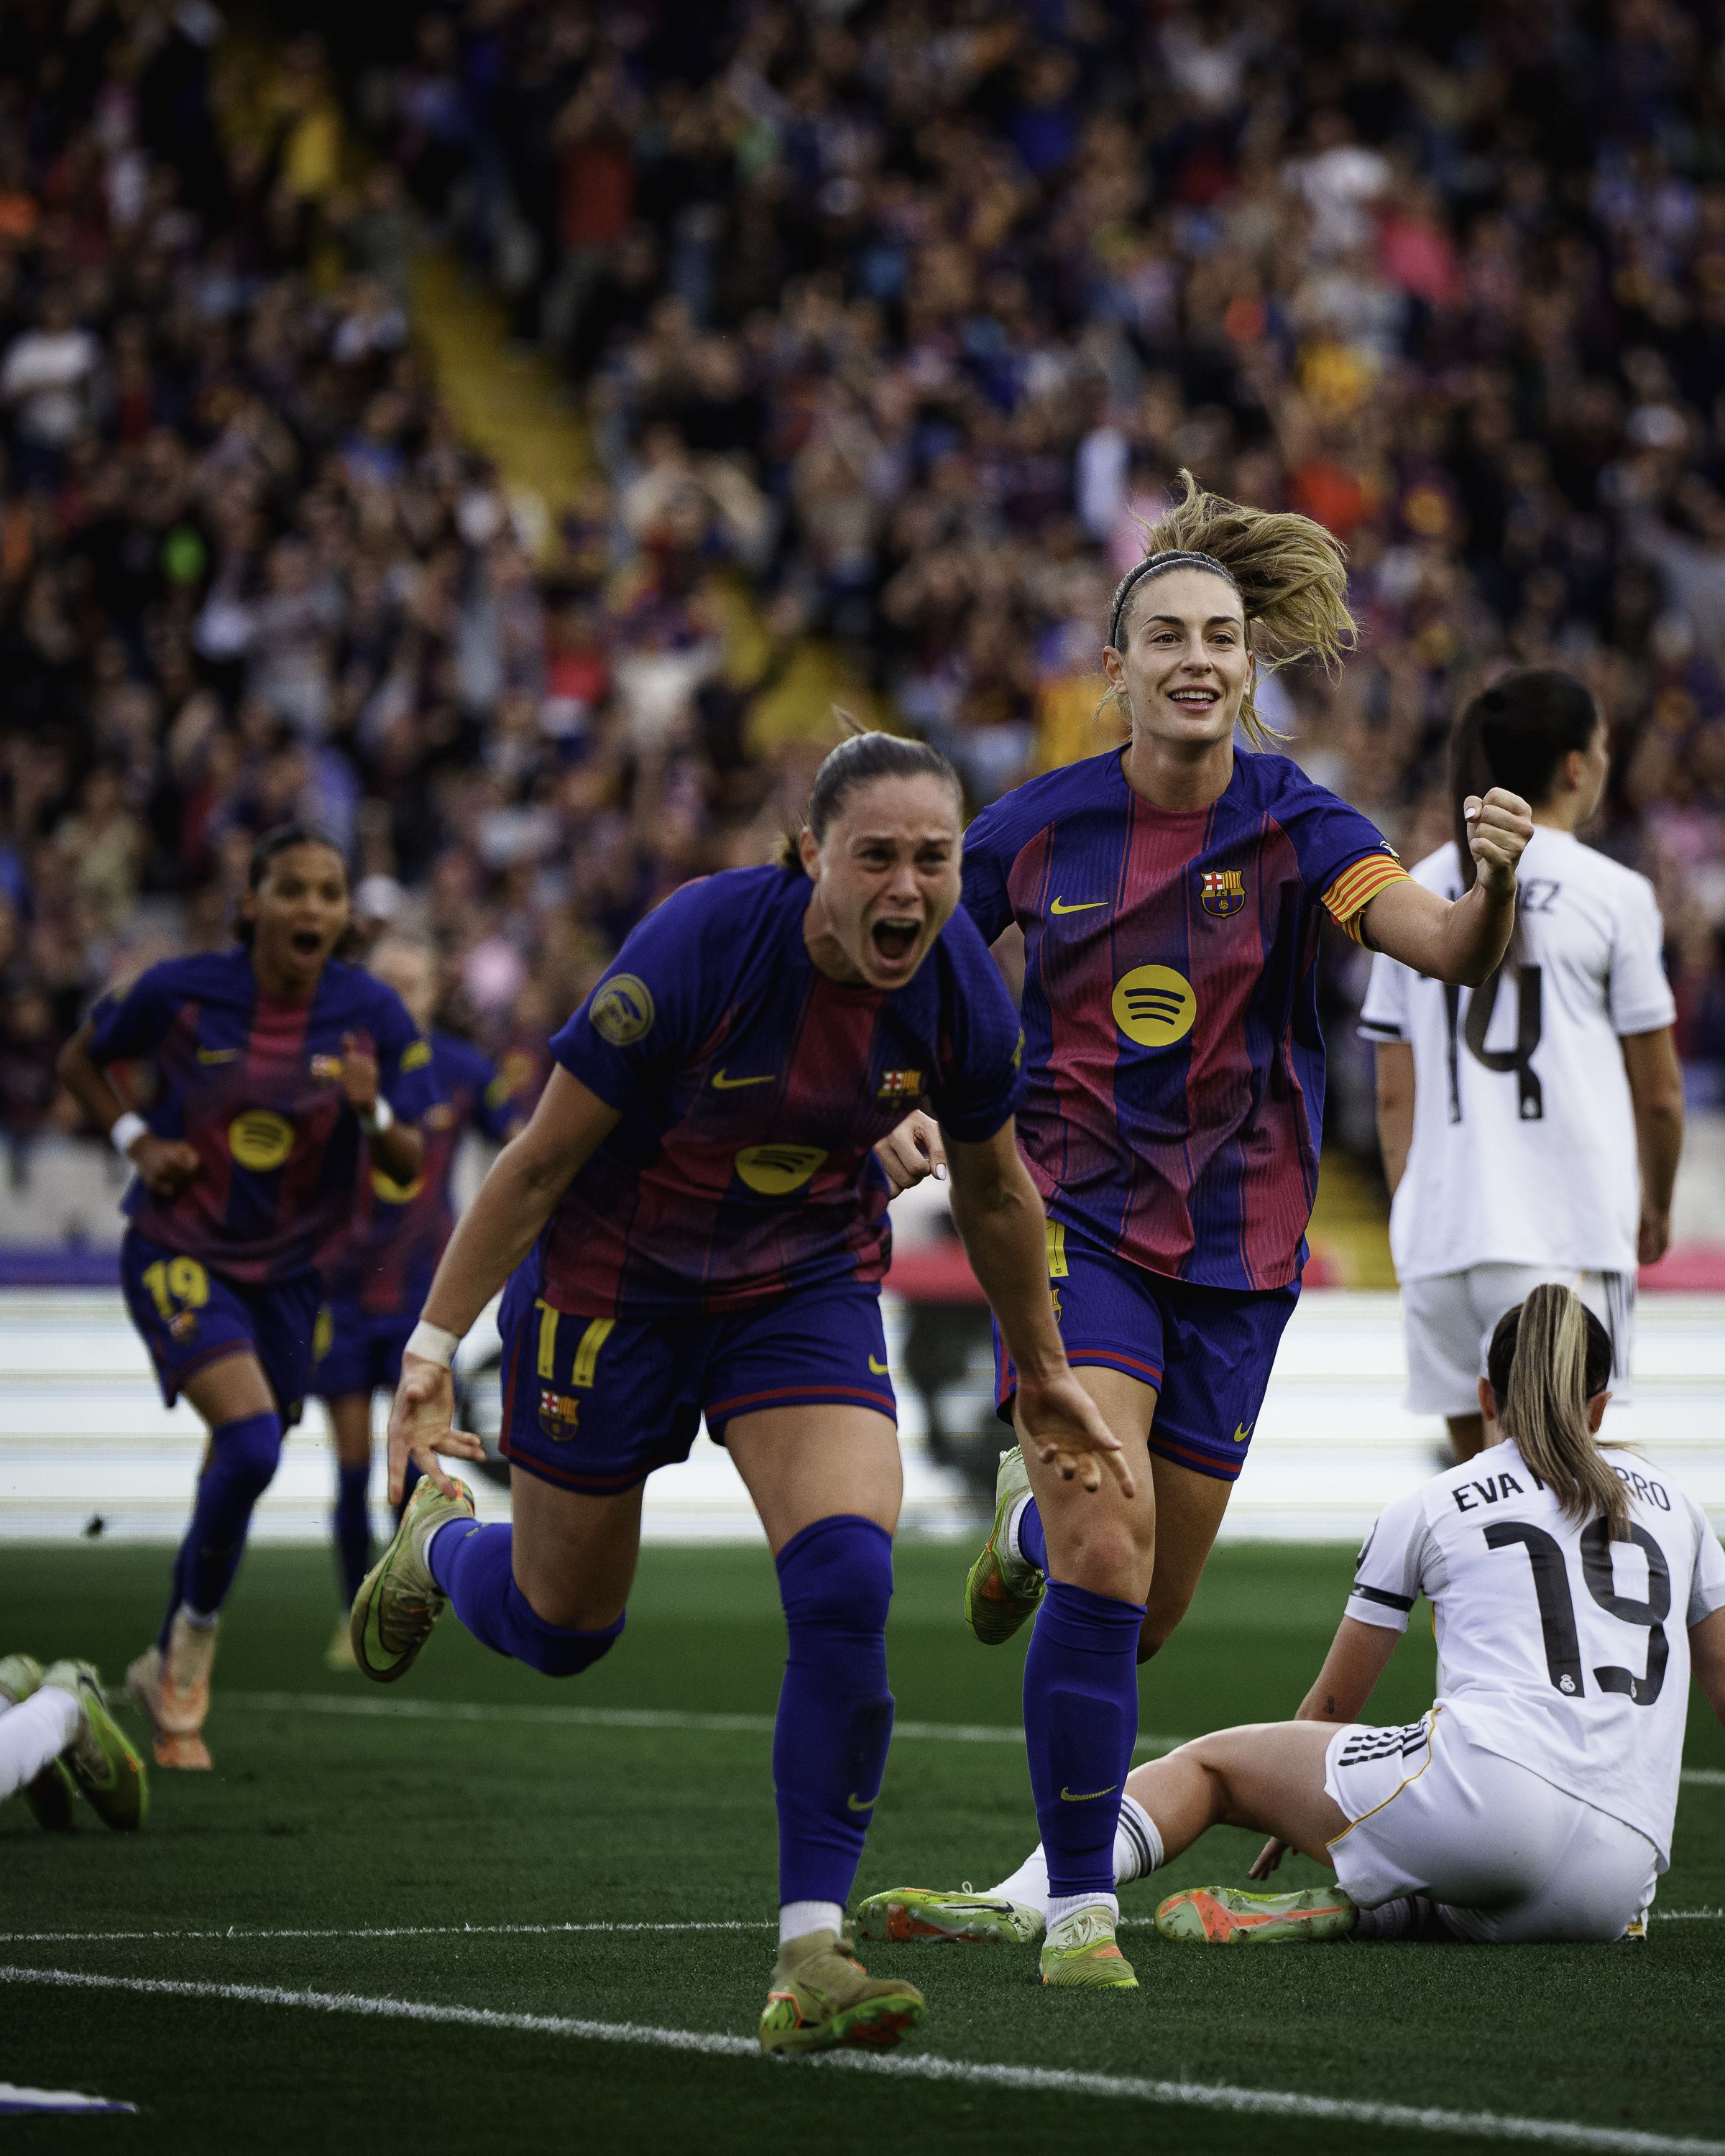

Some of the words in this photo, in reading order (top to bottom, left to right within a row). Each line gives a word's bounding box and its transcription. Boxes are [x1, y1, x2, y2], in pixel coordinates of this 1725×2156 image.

[141, 1256, 210, 1320] 19
[1451, 1473, 1524, 1513] EVA
[1483, 1514, 1671, 1706] 19
